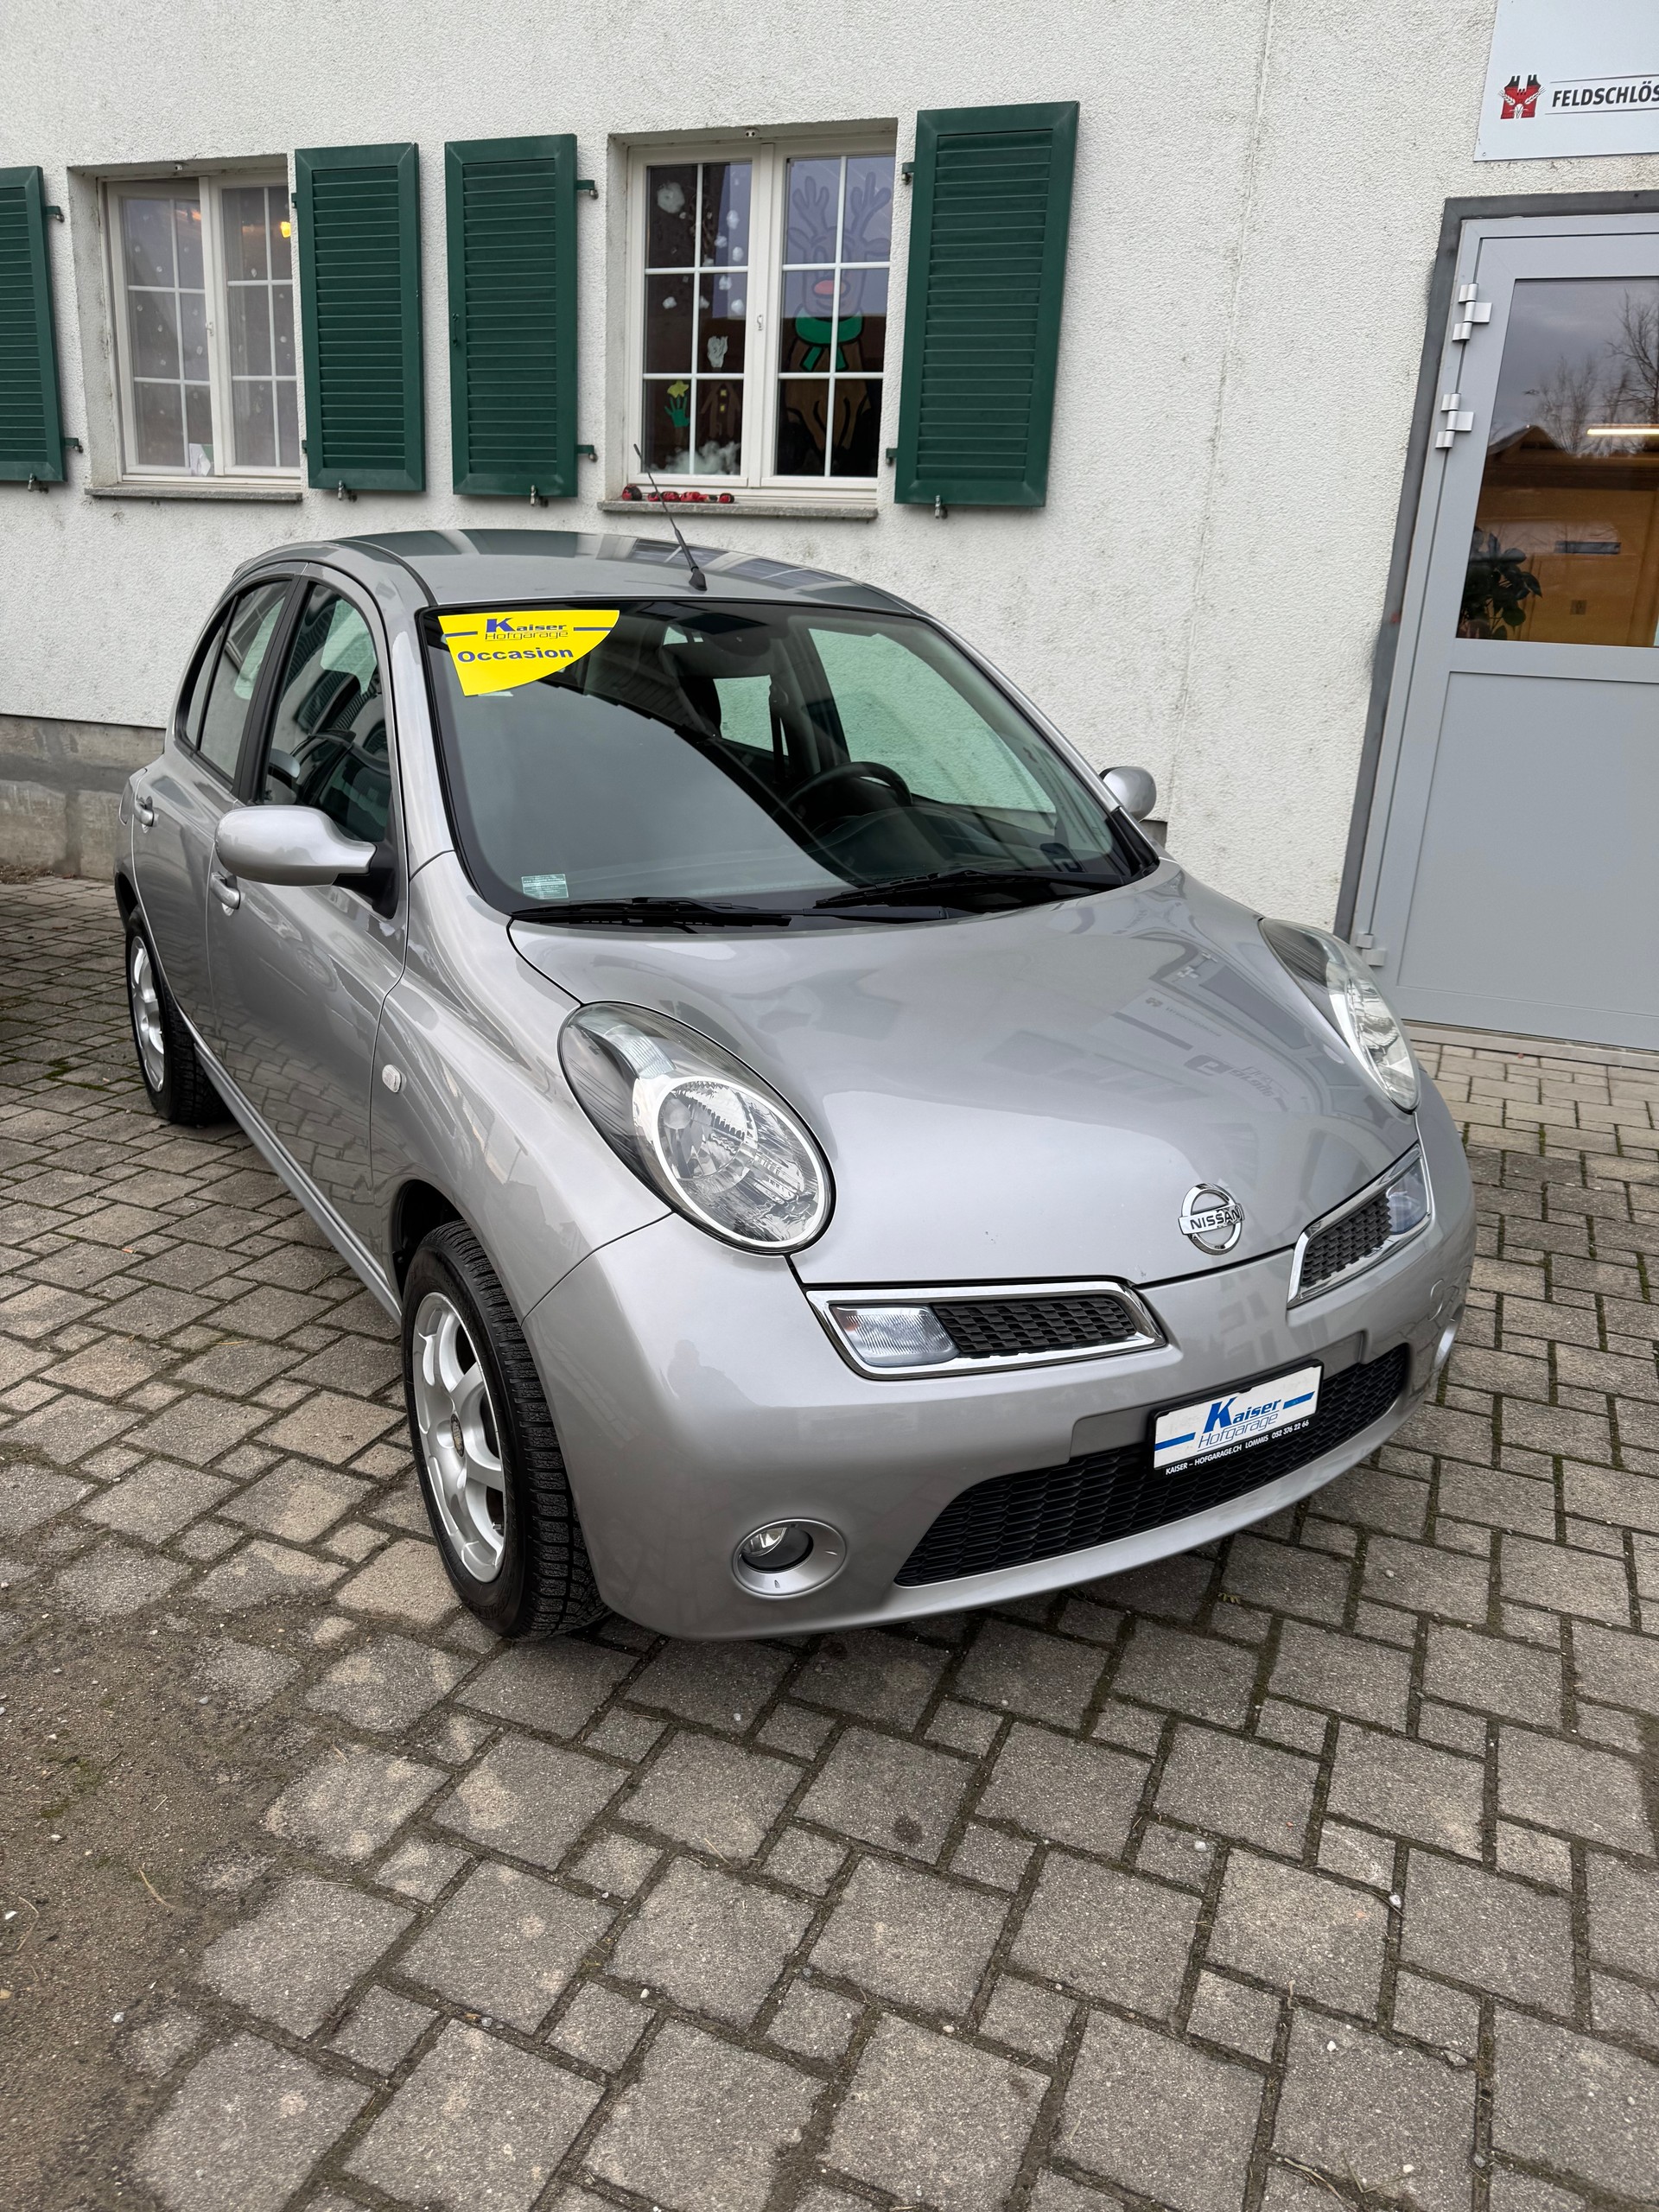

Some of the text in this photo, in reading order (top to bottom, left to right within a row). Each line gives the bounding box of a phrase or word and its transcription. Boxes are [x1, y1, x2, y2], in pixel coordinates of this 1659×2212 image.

[486, 617, 567, 632] Kaiser
[485, 631, 568, 642] Hofgarage
[457, 647, 574, 663] Occasion
[1190, 1207, 1241, 1230] NISSAN
[1203, 1396, 1281, 1434] Kaiser
[1198, 1413, 1278, 1448] Hofgarage
[1166, 1462, 1188, 1475] KAISER
[1194, 1444, 1243, 1466] HOFGARAGE.CH
[1271, 1429, 1283, 1440] 052
[1293, 1422, 1301, 1431] 22
[1301, 1419, 1310, 1427] 66
